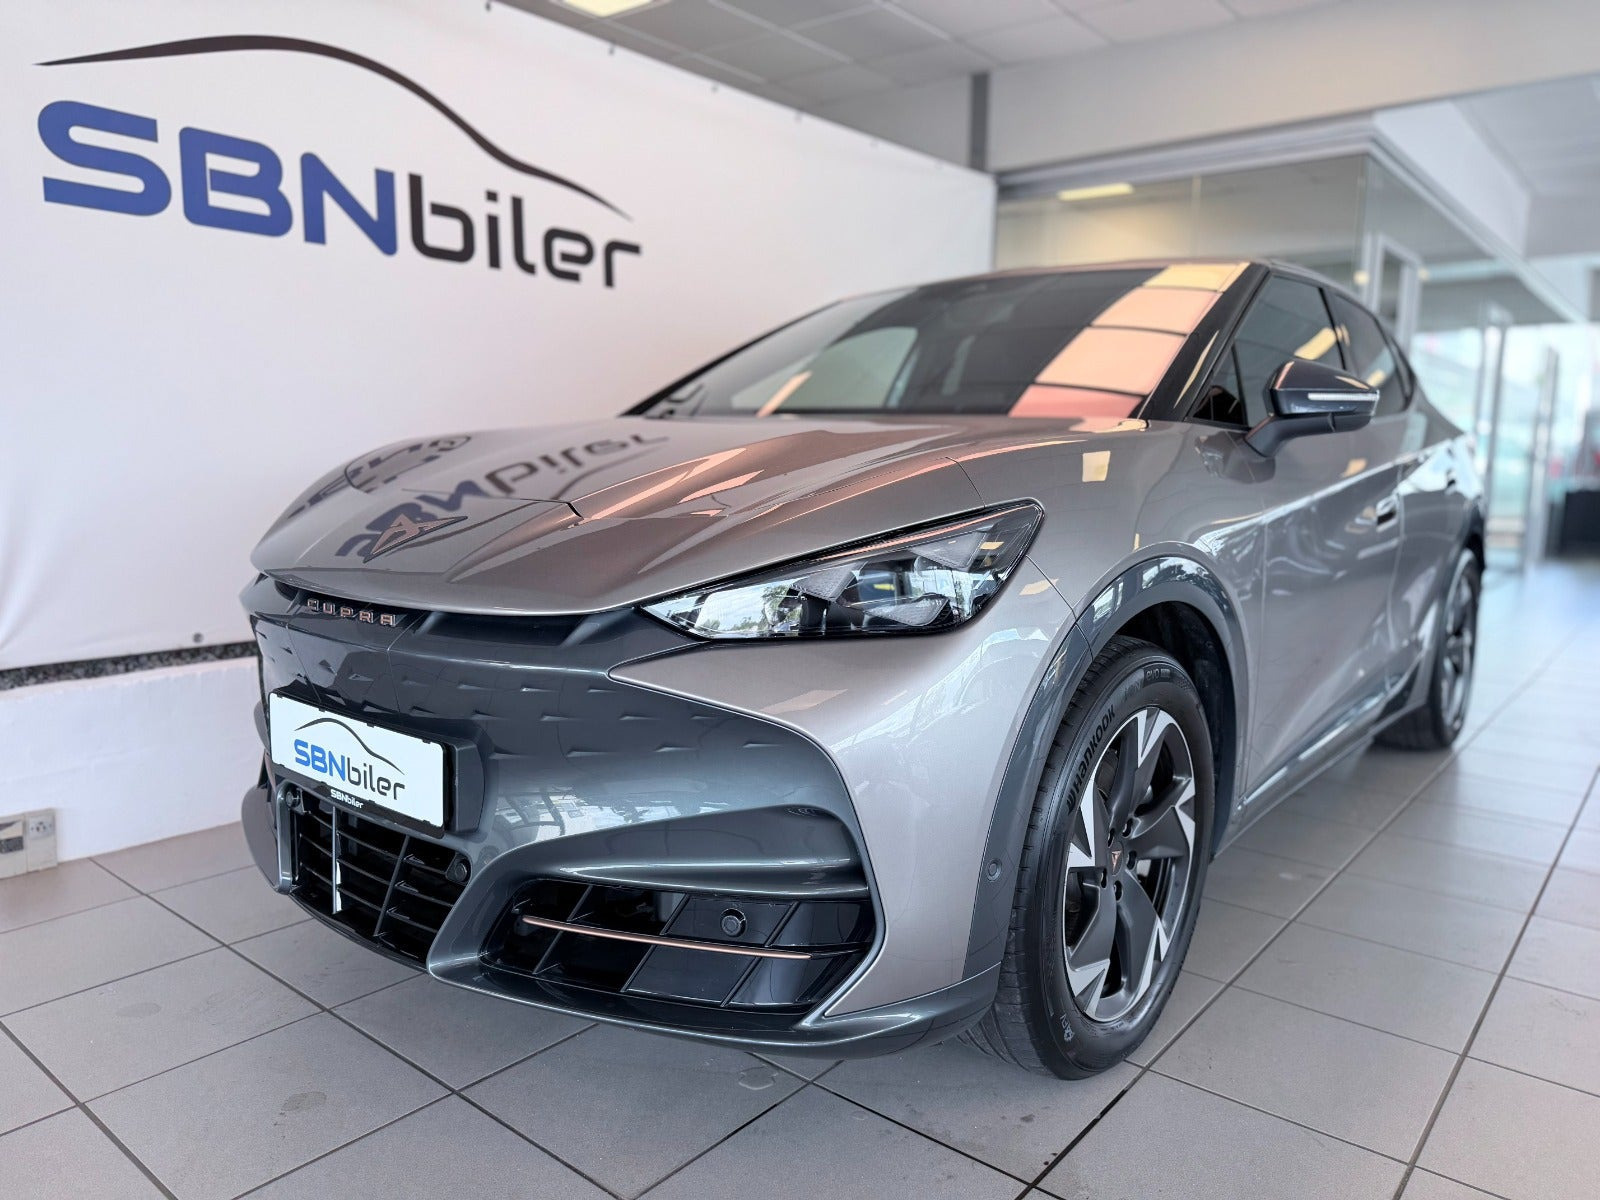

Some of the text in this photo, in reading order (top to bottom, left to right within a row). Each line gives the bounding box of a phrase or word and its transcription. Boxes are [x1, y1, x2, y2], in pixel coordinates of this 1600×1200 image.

[38, 101, 640, 287] SBNbiler
[307, 598, 396, 627] CUPRA
[294, 738, 405, 800] SBNbiler
[330, 788, 364, 809] SBNbiler
